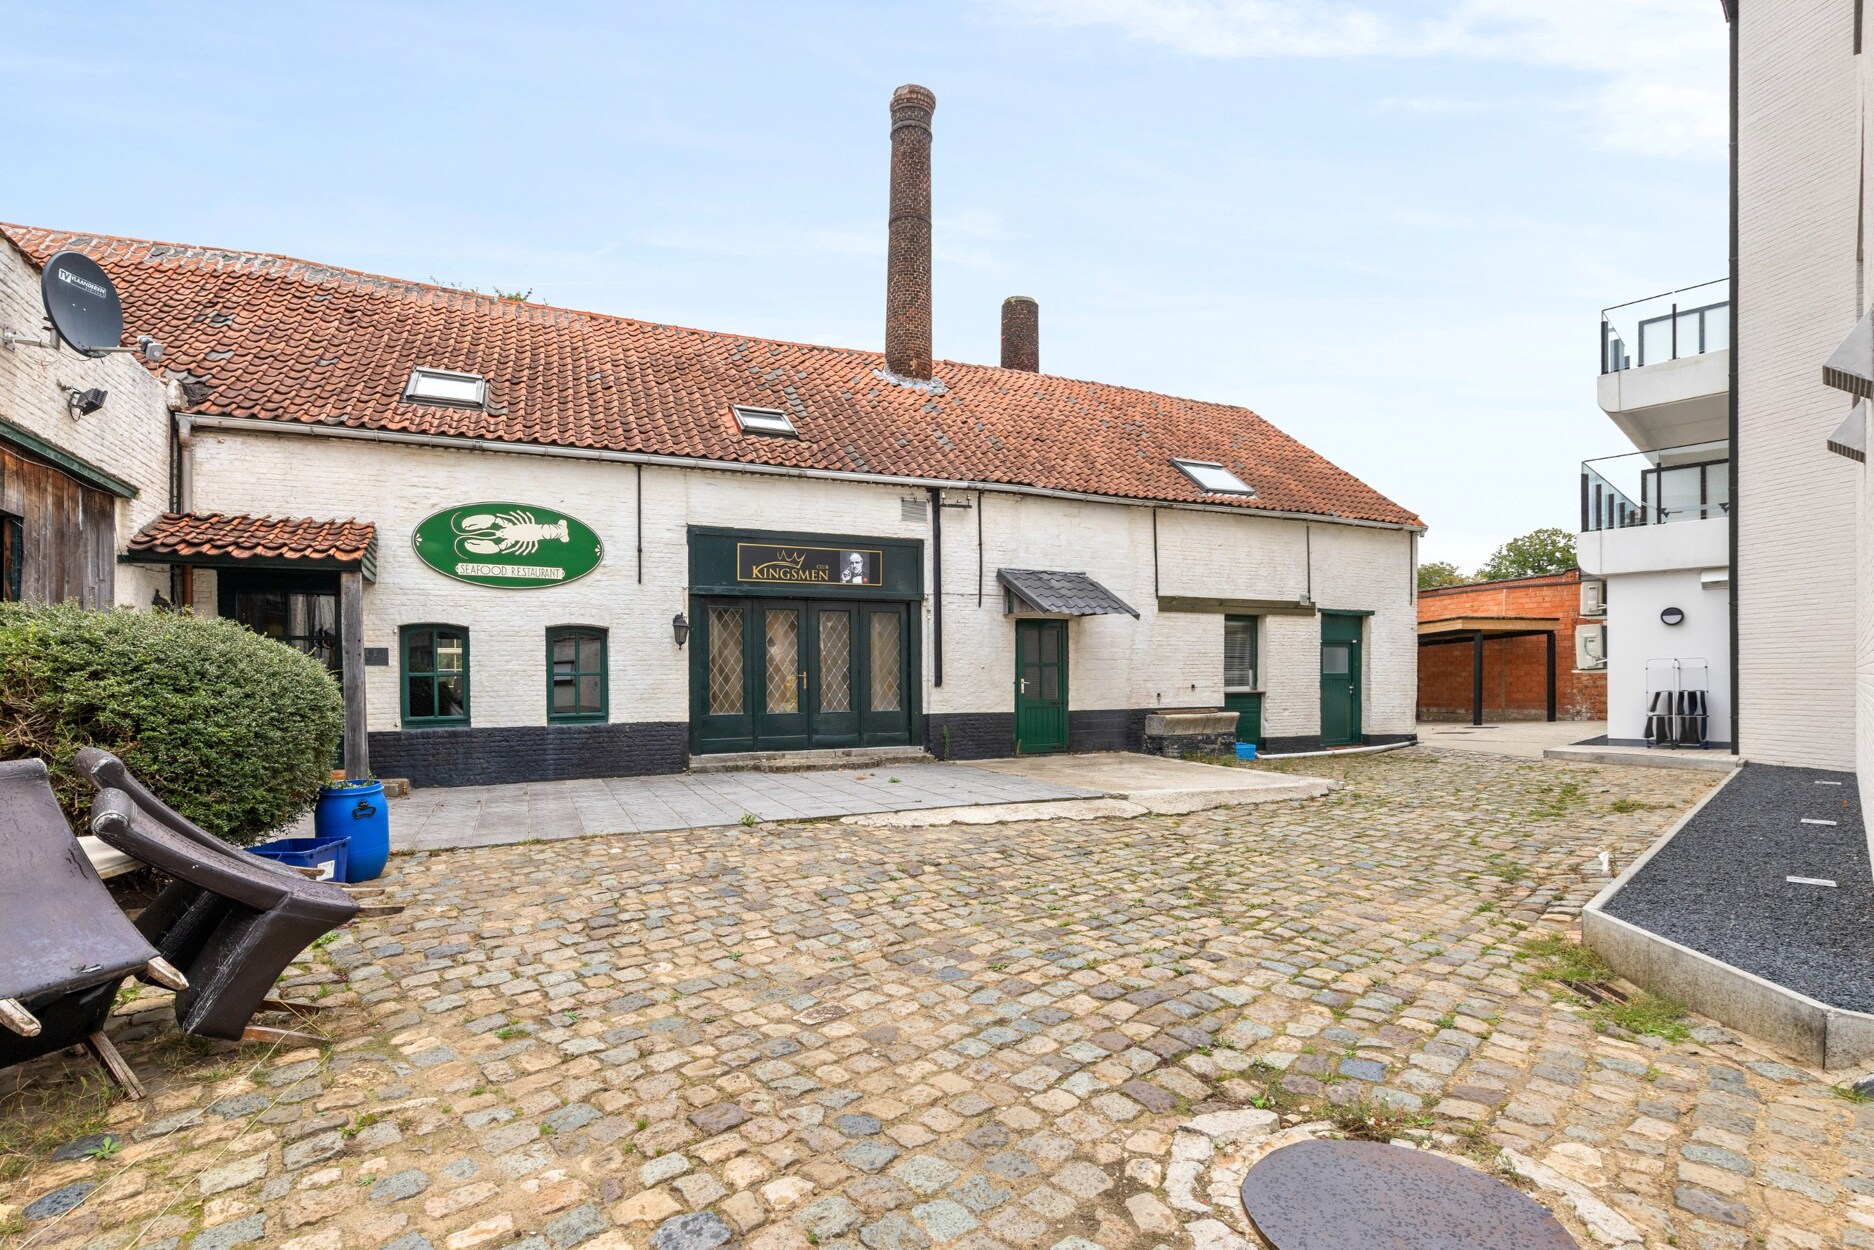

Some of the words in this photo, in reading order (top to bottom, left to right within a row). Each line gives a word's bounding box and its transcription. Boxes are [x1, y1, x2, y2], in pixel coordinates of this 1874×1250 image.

[60, 269, 70, 281] TV
[71, 275, 105, 294] VLAANDEREN
[460, 565, 507, 576] SEAFOOD
[511, 567, 559, 578] RESTAURANT
[752, 565, 829, 581] KINGSMEN
